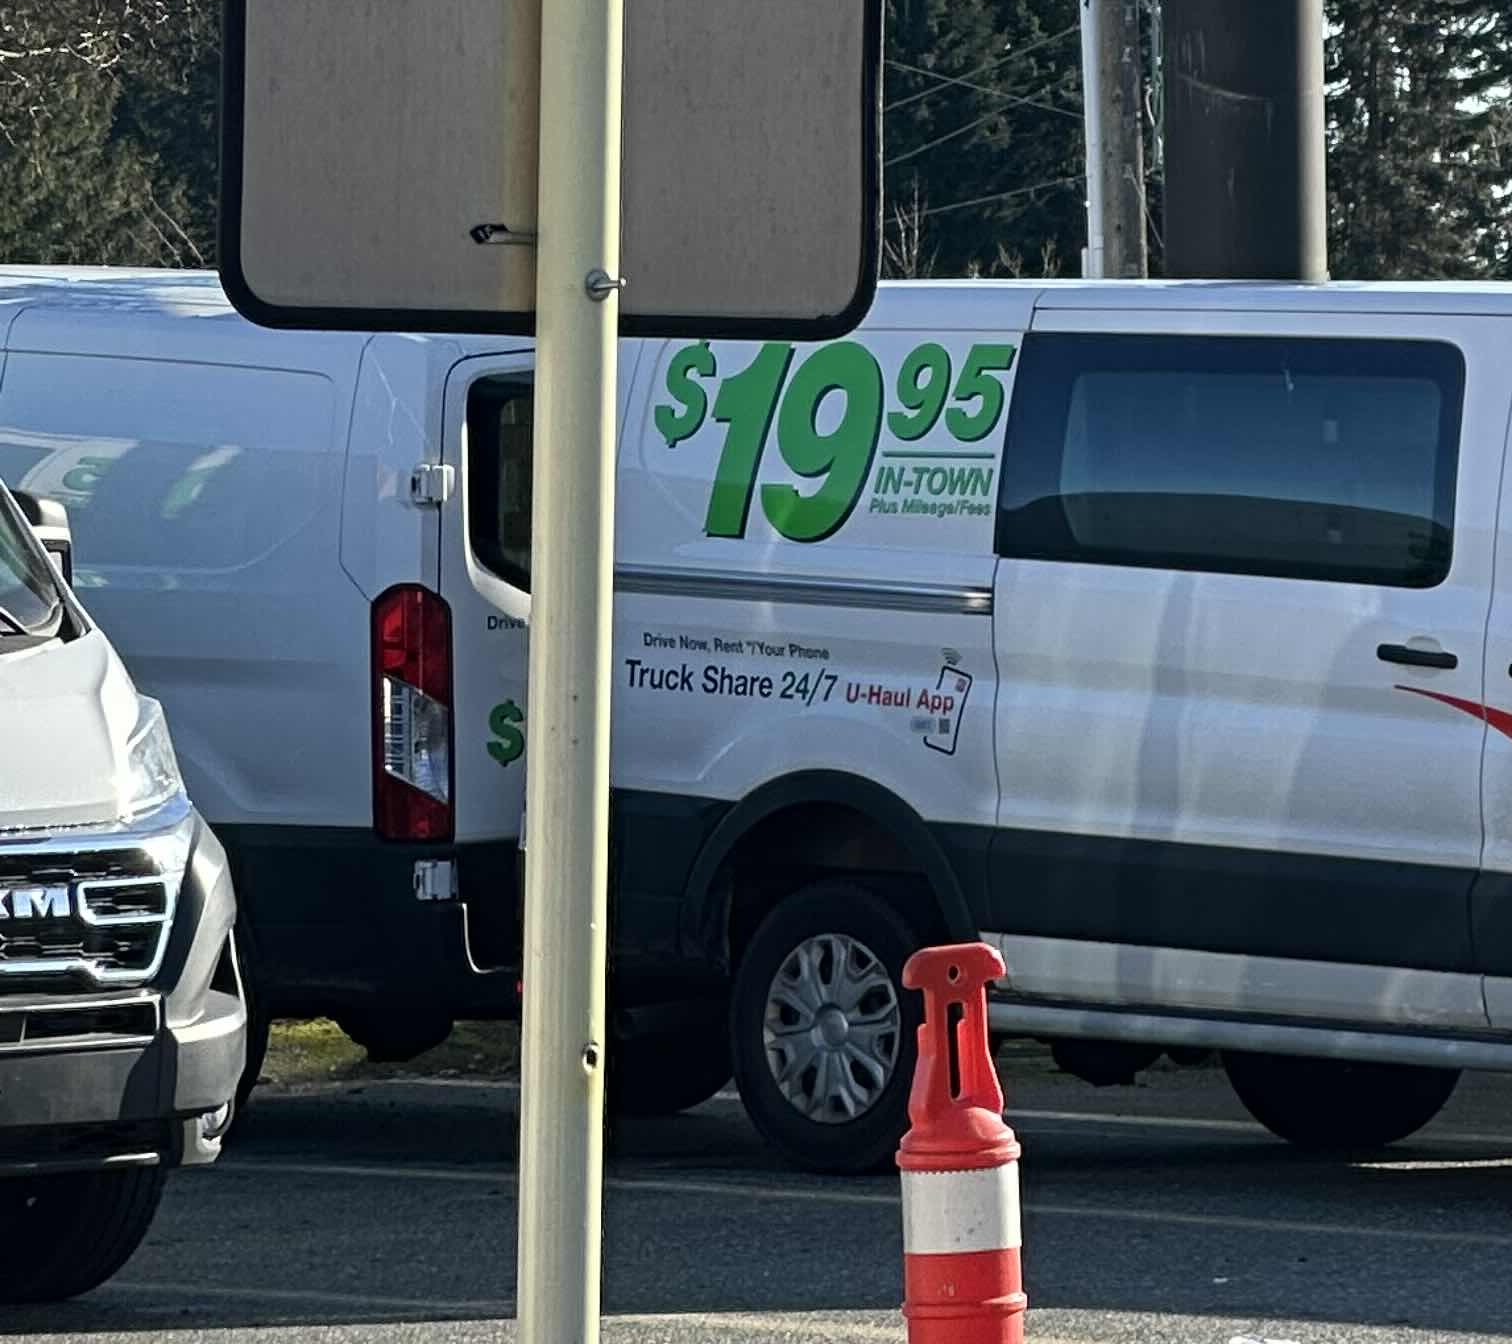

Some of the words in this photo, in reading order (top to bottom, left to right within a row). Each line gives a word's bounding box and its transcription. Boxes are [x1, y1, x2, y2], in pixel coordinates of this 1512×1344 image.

[874, 466, 994, 496] IN-TOWN
[869, 498, 898, 514] Plus
[643, 632, 676, 649] Drive
[679, 635, 711, 653] Now,
[714, 638, 744, 655] Rent
[789, 644, 830, 660] Phone
[625, 659, 694, 692] Truck
[702, 664, 773, 698] Share
[780, 668, 838, 706] 24/7
[846, 682, 910, 709] U-Haul
[916, 688, 954, 714] App
